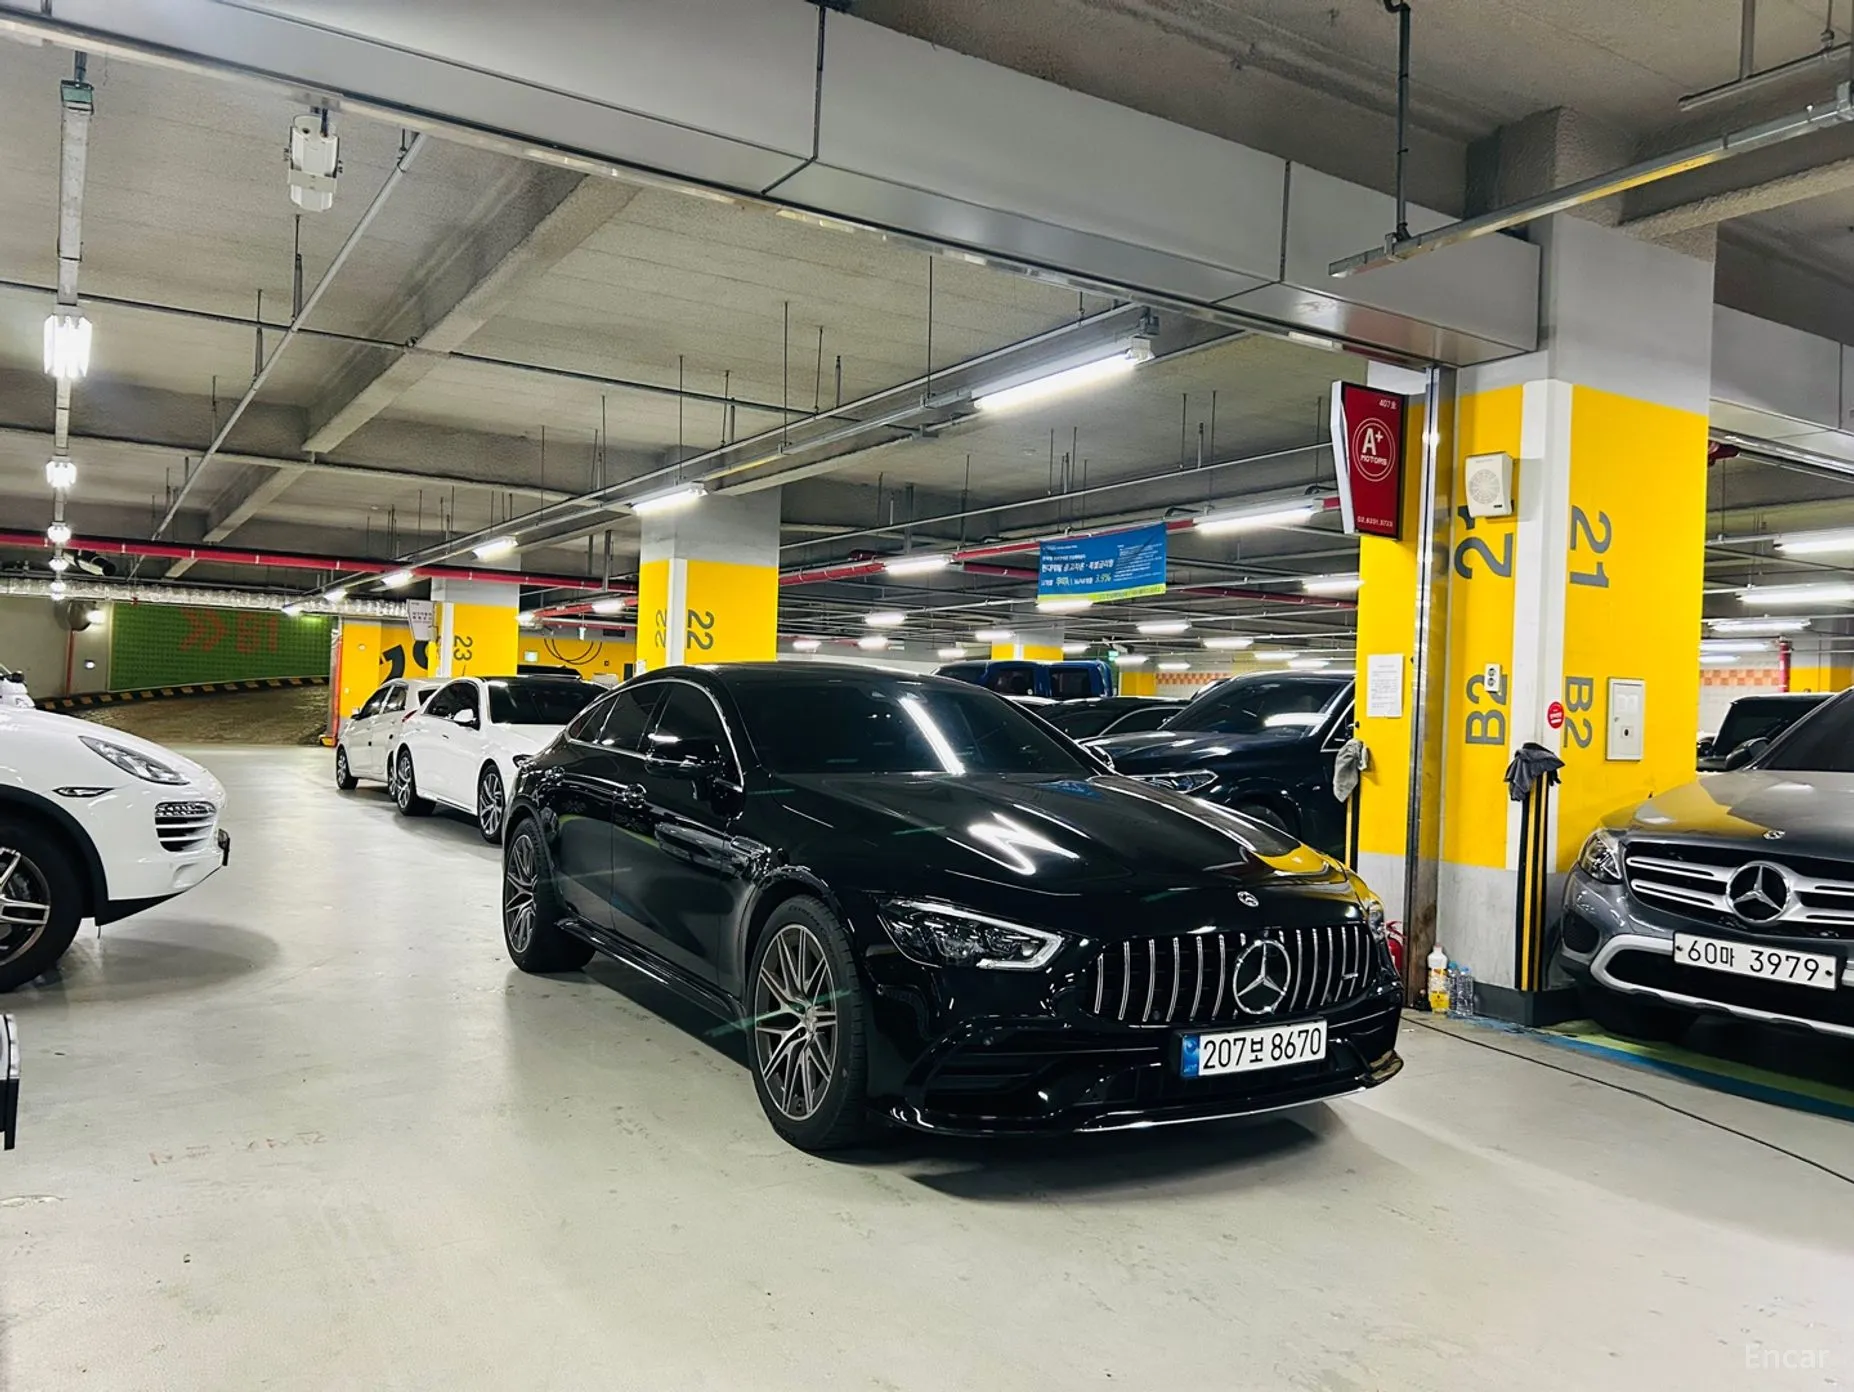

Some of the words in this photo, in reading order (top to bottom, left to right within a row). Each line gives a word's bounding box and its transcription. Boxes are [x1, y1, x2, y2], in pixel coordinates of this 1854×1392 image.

[1360, 454, 1388, 467] MOTORS
[1361, 427, 1383, 456] A+
[1569, 505, 1612, 588] 21
[453, 634, 473, 661] 23
[655, 608, 667, 648] 22
[686, 608, 715, 650] 22
[1465, 674, 1508, 745] B2
[1563, 676, 1594, 749] B2
[1688, 940, 1735, 968] 60마
[1749, 949, 1820, 982] 3979
[1203, 1036, 1265, 1070] 207보
[1270, 1027, 1323, 1062] 8670
